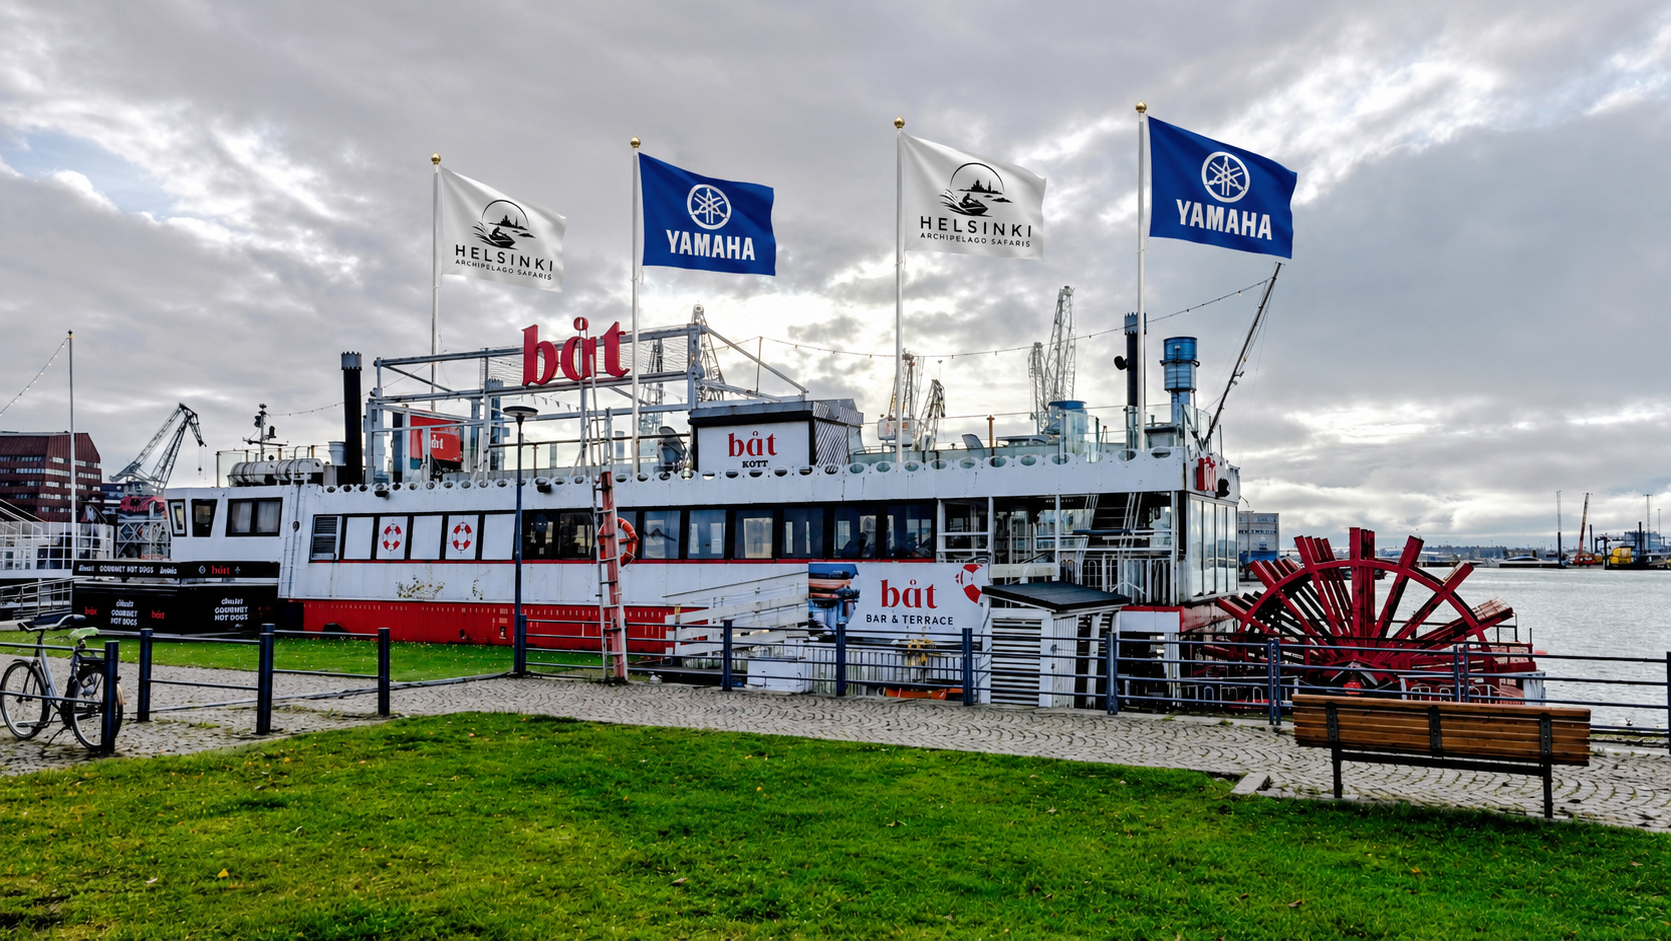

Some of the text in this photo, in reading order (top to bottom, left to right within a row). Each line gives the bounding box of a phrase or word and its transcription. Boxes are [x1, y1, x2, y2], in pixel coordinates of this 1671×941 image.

[920, 215, 1032, 238] HELSINKI
[1176, 198, 1273, 240] YAMAHA
[665, 229, 756, 261] YAMAHA
[920, 232, 1031, 248] ARCHIPELAGO SAFARIS
[455, 244, 553, 272] HELSINKI
[455, 259, 552, 280] ARCHIPELAGO SAFARIS
[521, 316, 631, 386] båt
[727, 430, 778, 457] båt
[880, 579, 938, 609] båt
[866, 614, 954, 625] BAR & TERRACE
